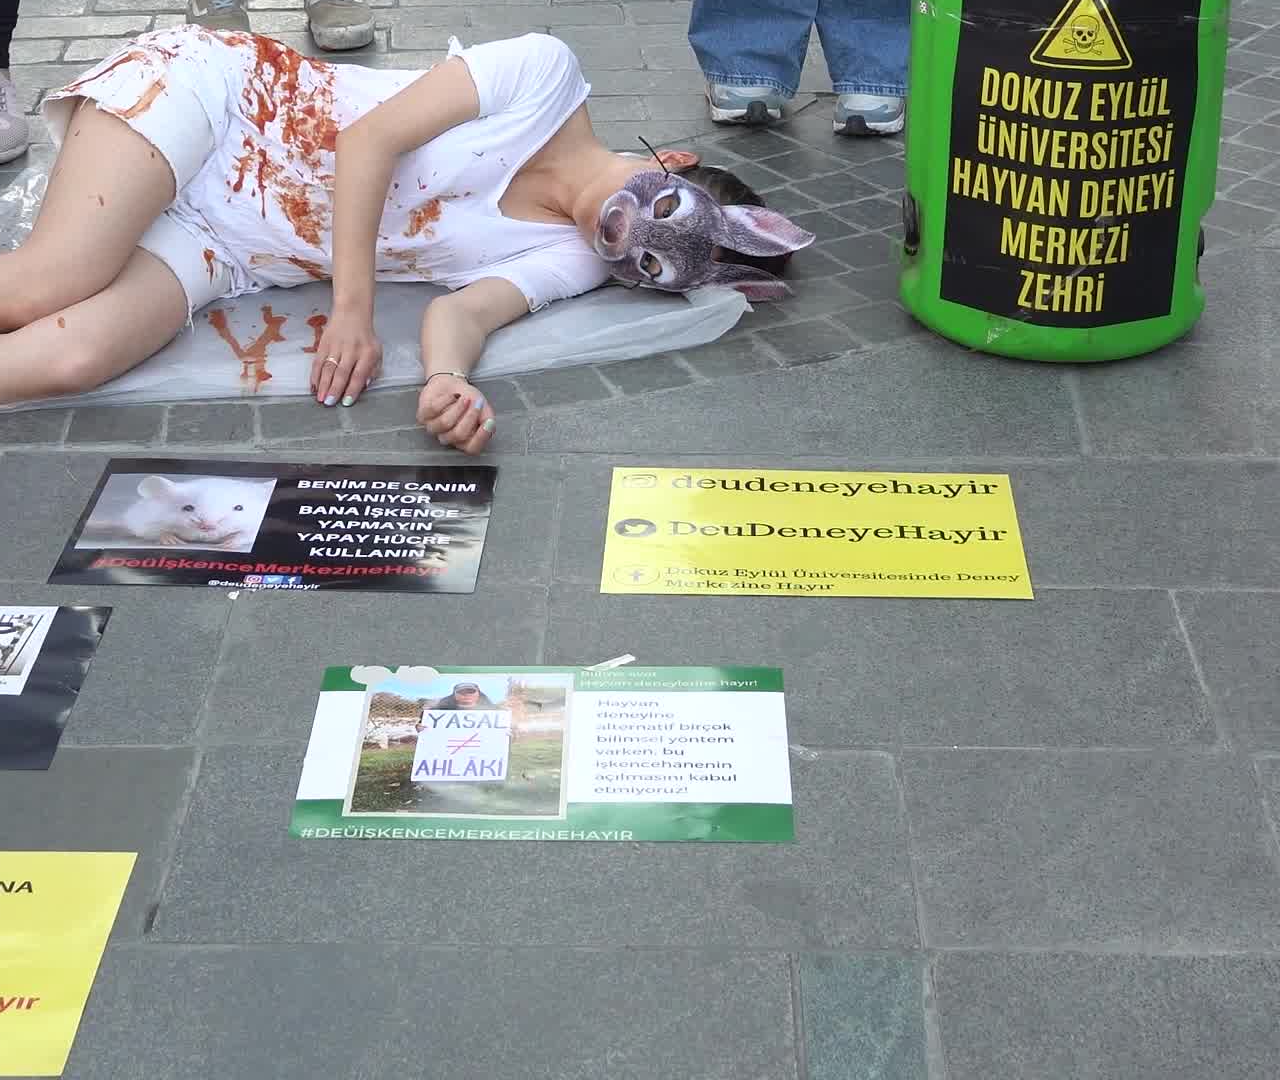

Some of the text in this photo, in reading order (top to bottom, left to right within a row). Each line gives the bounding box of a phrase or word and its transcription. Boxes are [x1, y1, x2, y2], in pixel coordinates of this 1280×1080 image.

[981, 67, 1171, 122] DOKUZ EYLÜL
[977, 113, 1174, 170] ÜNİVERSİTESİ
[952, 157, 1176, 219] HAYVAN DENEYİ
[1000, 217, 1130, 267] MERKEZİ
[1017, 269, 1105, 313] ZEHRİ
[297, 478, 477, 493] BENİM DE CANIM
[671, 476, 999, 499] deudeneyehayir
[335, 493, 432, 504] YANIYOR
[298, 505, 461, 519] BANA İŞKENCE
[318, 520, 433, 532] YAPMAYIN
[669, 520, 1009, 546] DeuDeneyeHayir
[297, 532, 452, 546] YAPAY HÜCRE
[309, 546, 426, 559] KULLANIN
[733, 568, 788, 581] Eylül
[792, 568, 952, 582] Üniversitesinde
[956, 572, 1020, 584] Deney
[428, 712, 508, 730] YASAL
[662, 748, 685, 756] bu
[689, 773, 738, 782] kabul
